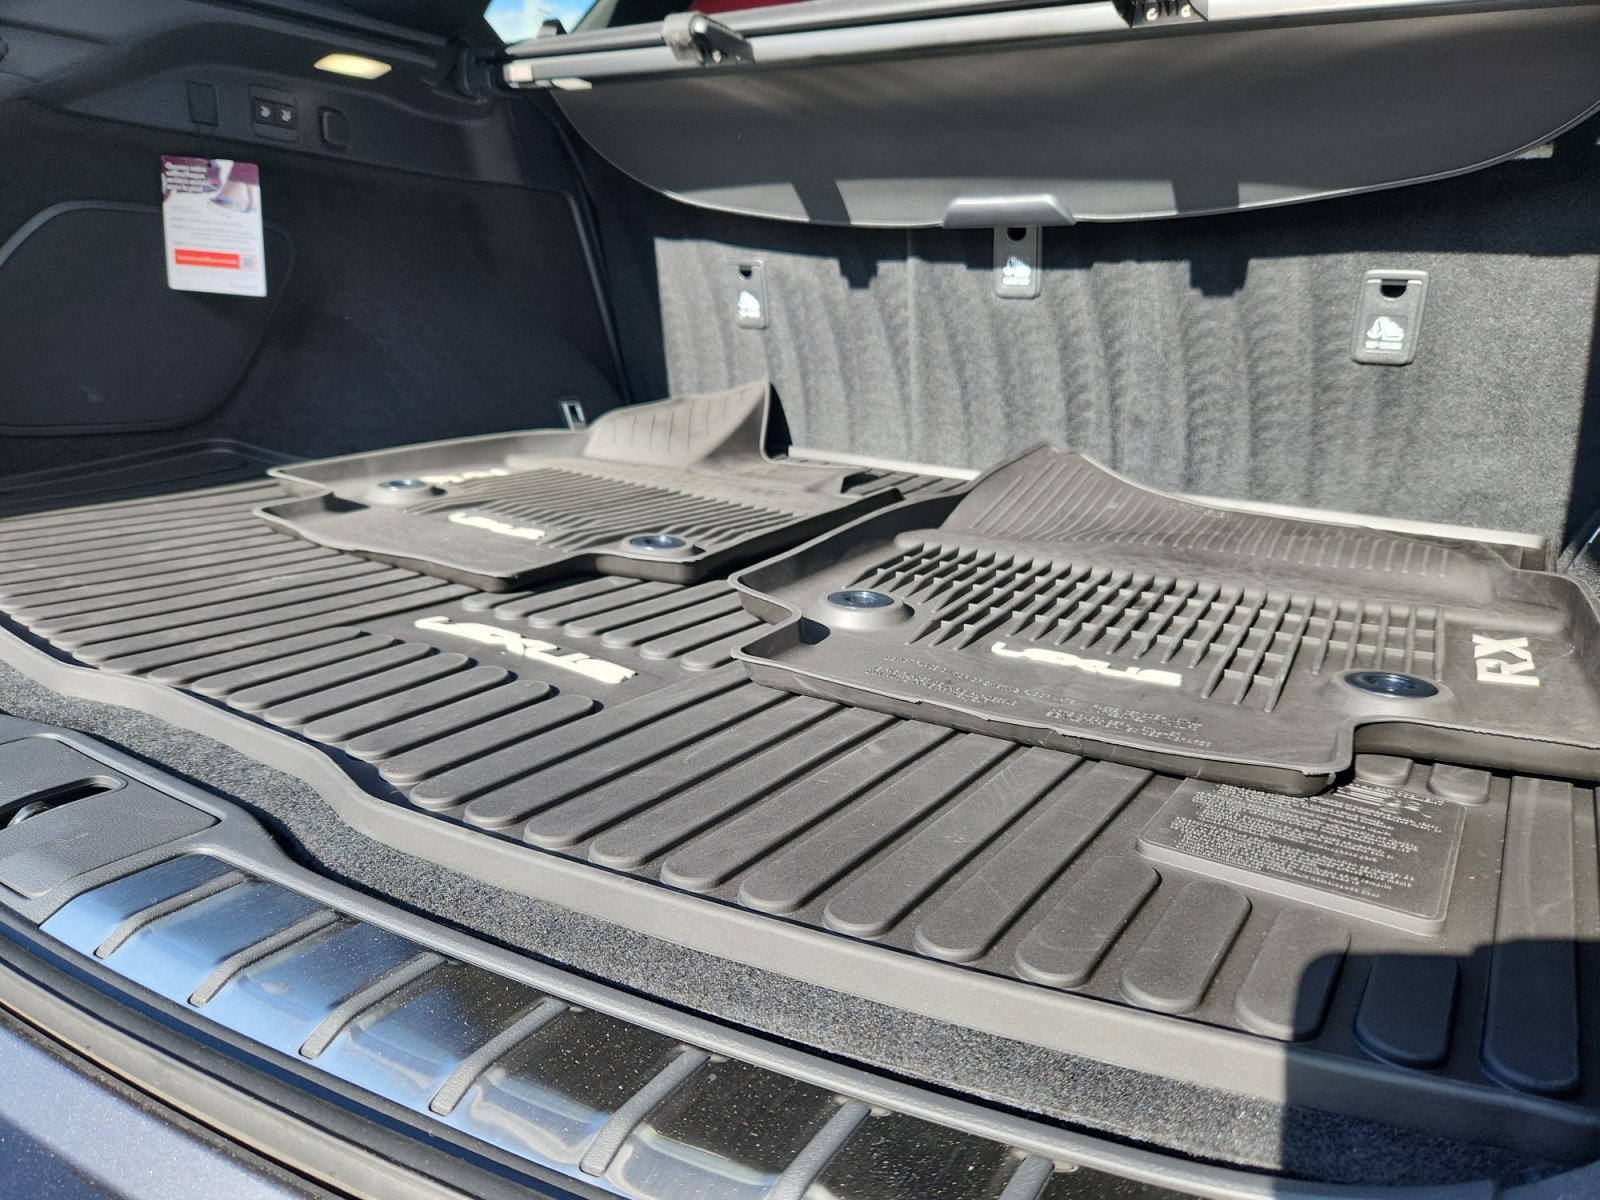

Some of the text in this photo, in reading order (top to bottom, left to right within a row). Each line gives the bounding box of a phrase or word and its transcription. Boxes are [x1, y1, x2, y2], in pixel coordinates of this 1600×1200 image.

[414, 616, 638, 684] LEXUS
[991, 641, 1183, 687] LEXUS
[1472, 634, 1540, 687] RX
